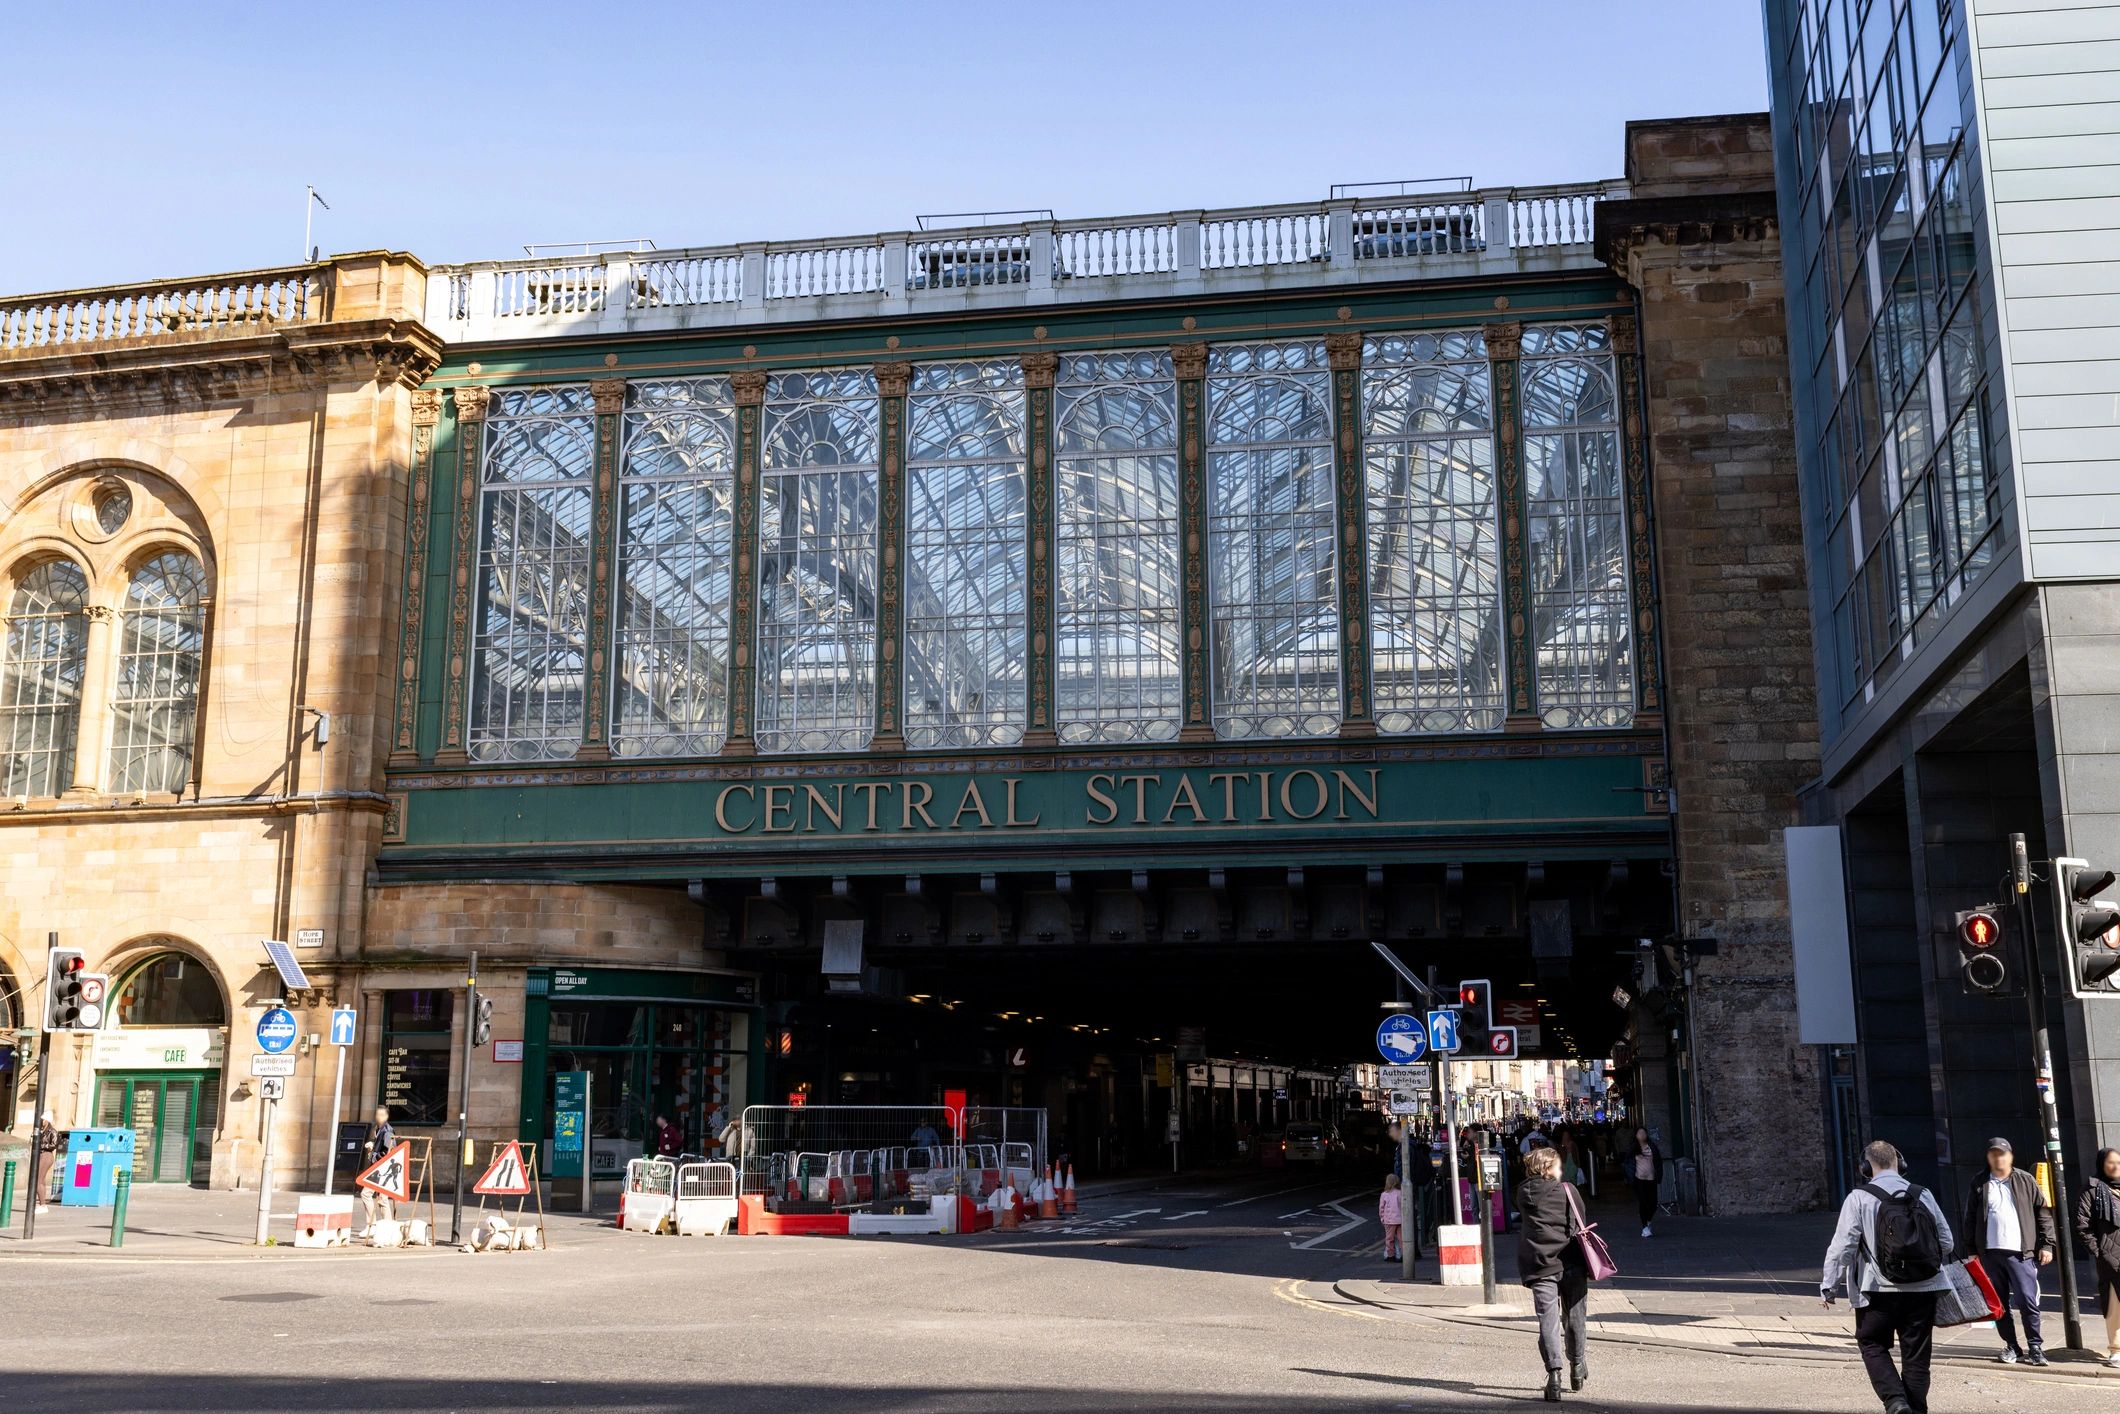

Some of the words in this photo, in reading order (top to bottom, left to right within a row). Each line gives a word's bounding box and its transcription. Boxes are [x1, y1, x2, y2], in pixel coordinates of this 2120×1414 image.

[714, 778, 1041, 833] CENTRAL
[1085, 768, 1383, 825] STATION
[164, 1049, 186, 1063] CAFE
[596, 1155, 614, 1167] CAFE
